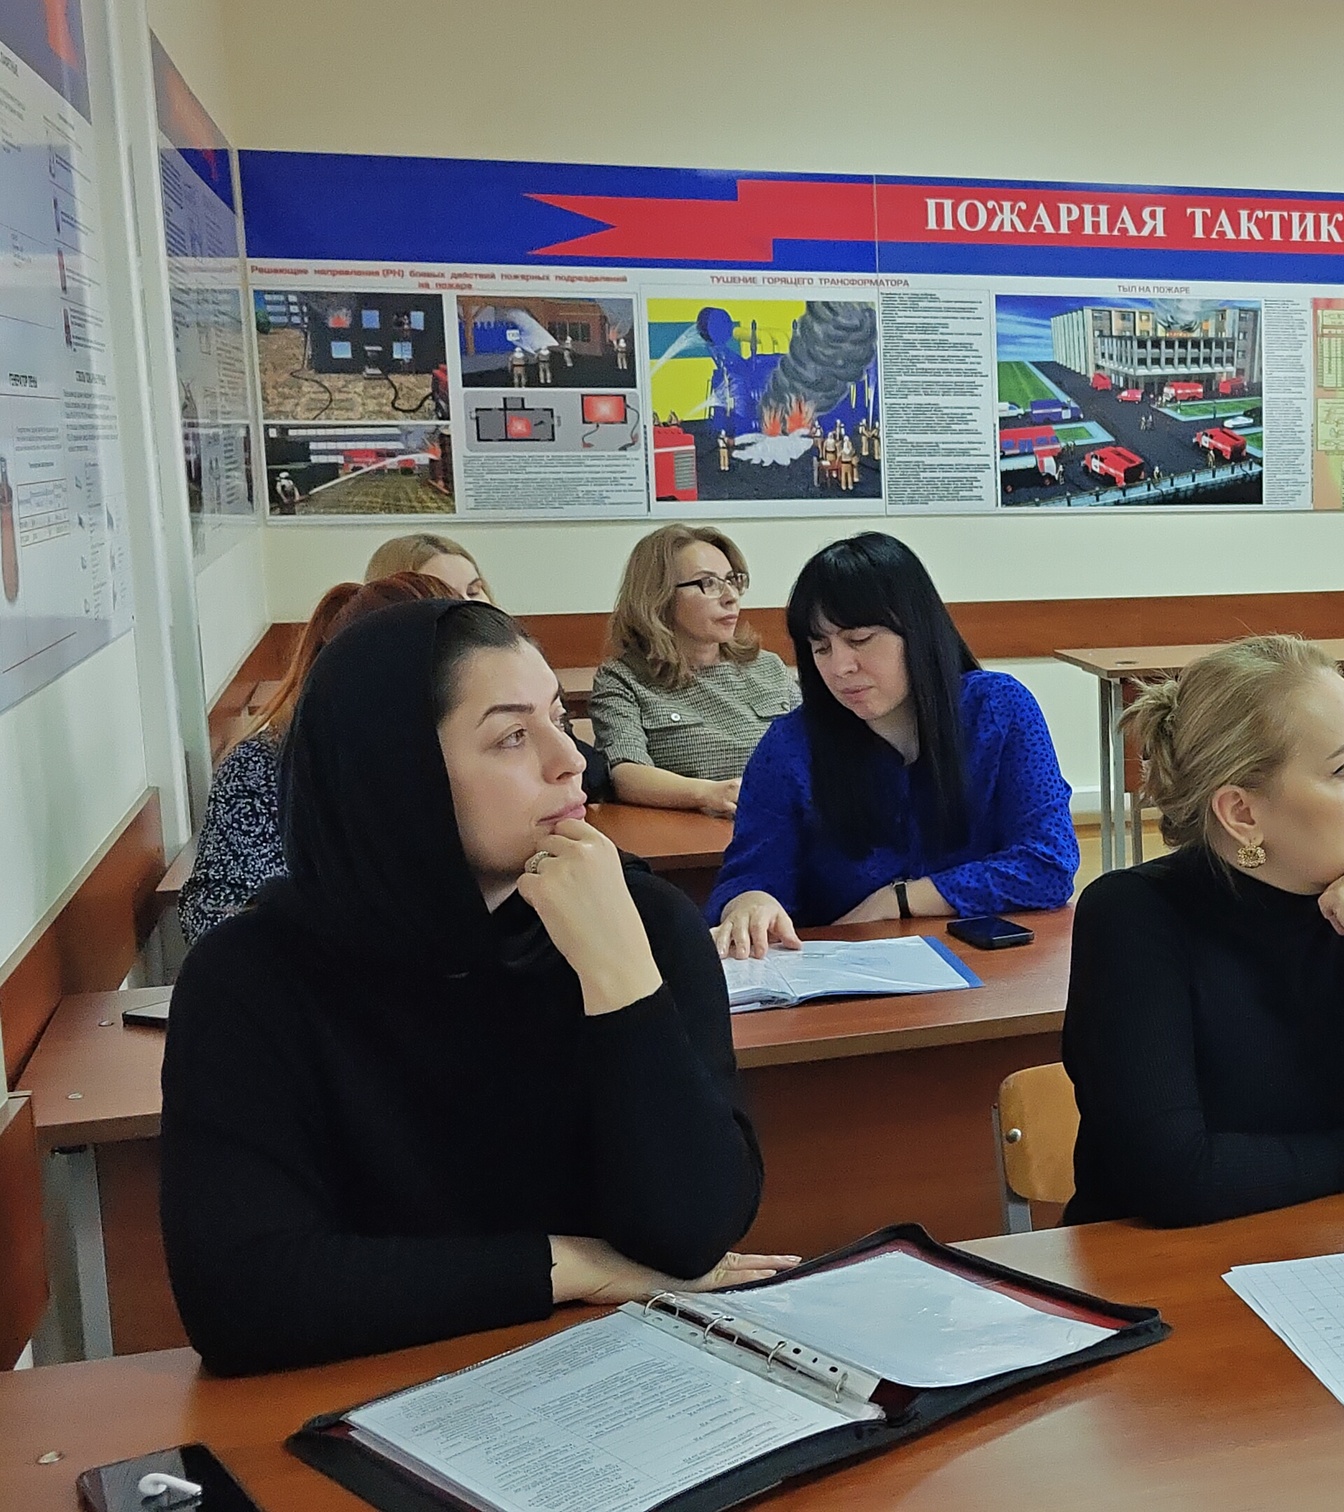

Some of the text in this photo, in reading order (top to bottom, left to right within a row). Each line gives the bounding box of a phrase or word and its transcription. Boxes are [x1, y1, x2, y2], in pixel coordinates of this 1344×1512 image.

[925, 198, 1167, 238] ПОЖАРНАЯ
[710, 275, 910, 288] ТУШЕНИЕ ГОРЯЩЕГО ТРАНСФОРМАТОРА
[1117, 285, 1191, 294] ТЫЛ НА ПОЖАРЕ
